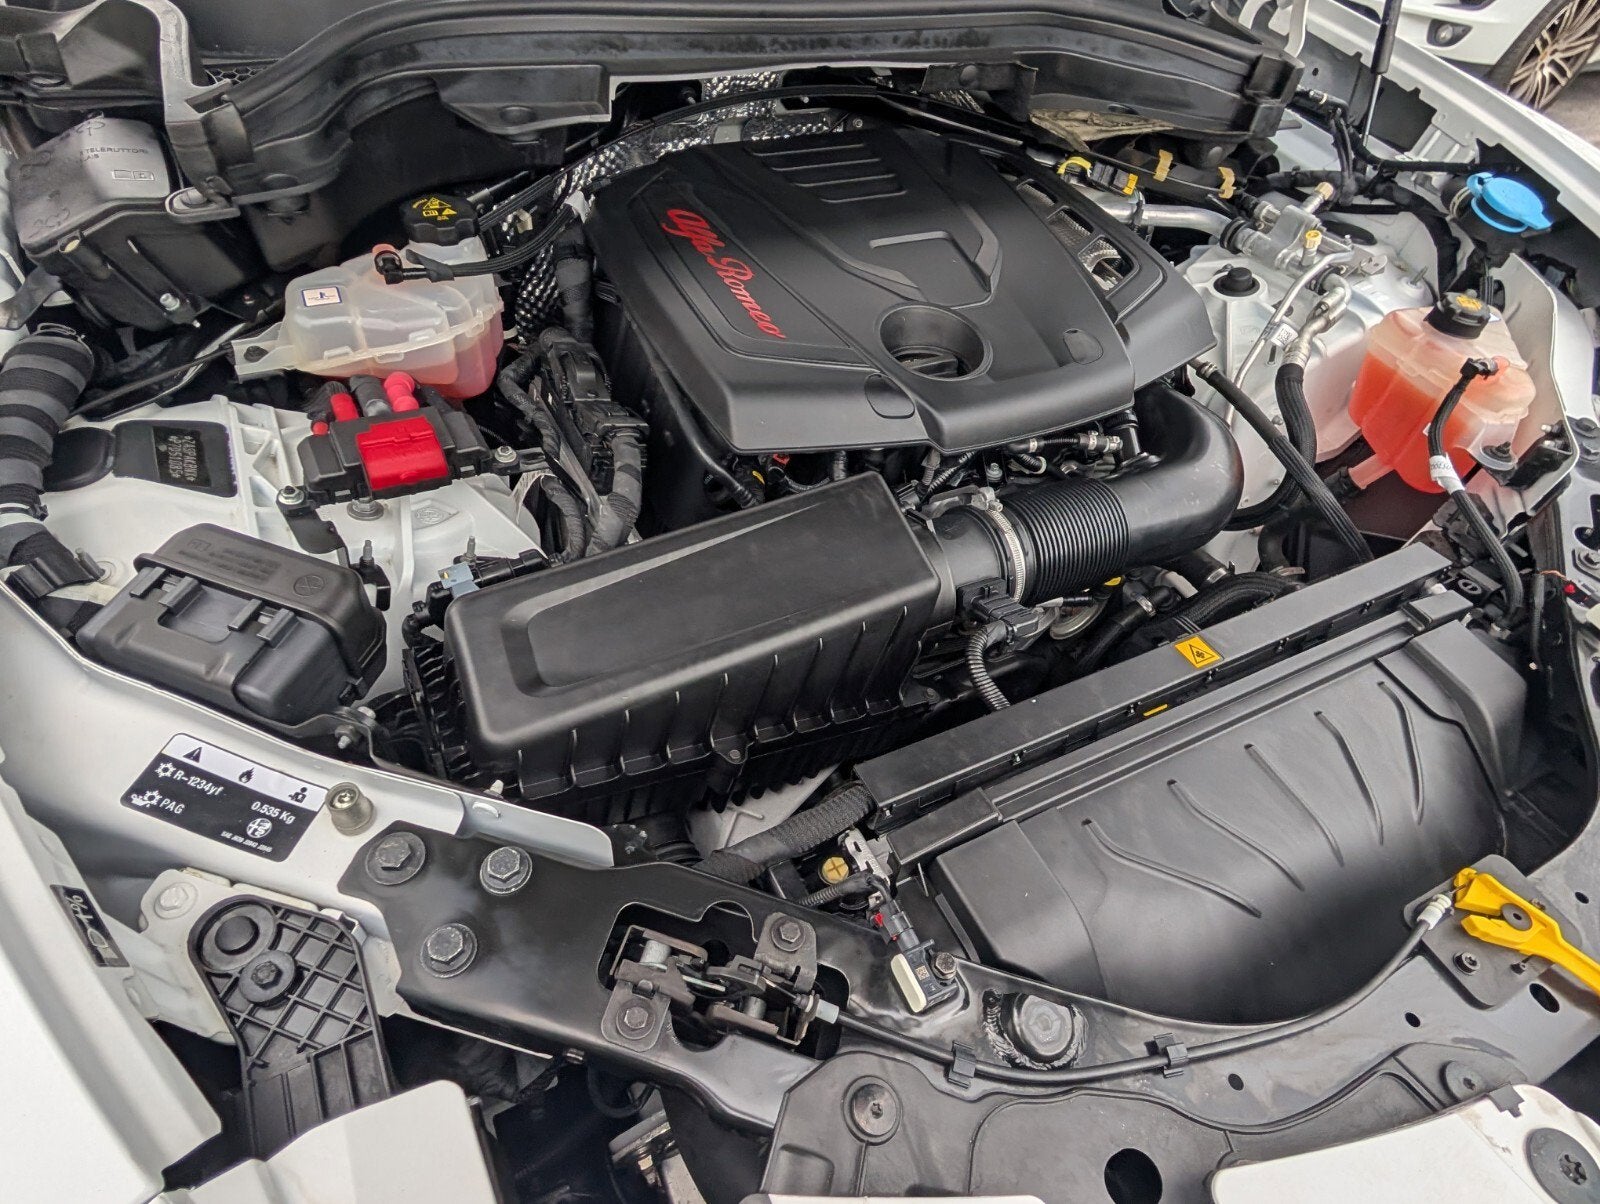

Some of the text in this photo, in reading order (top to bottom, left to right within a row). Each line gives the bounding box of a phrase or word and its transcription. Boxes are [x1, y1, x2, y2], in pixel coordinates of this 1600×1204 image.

[661, 208, 787, 339] Alfa Romeo
[173, 770, 224, 795] R-1234yf
[160, 798, 186, 814] PAG
[251, 801, 296, 825] 0.535 Kg
